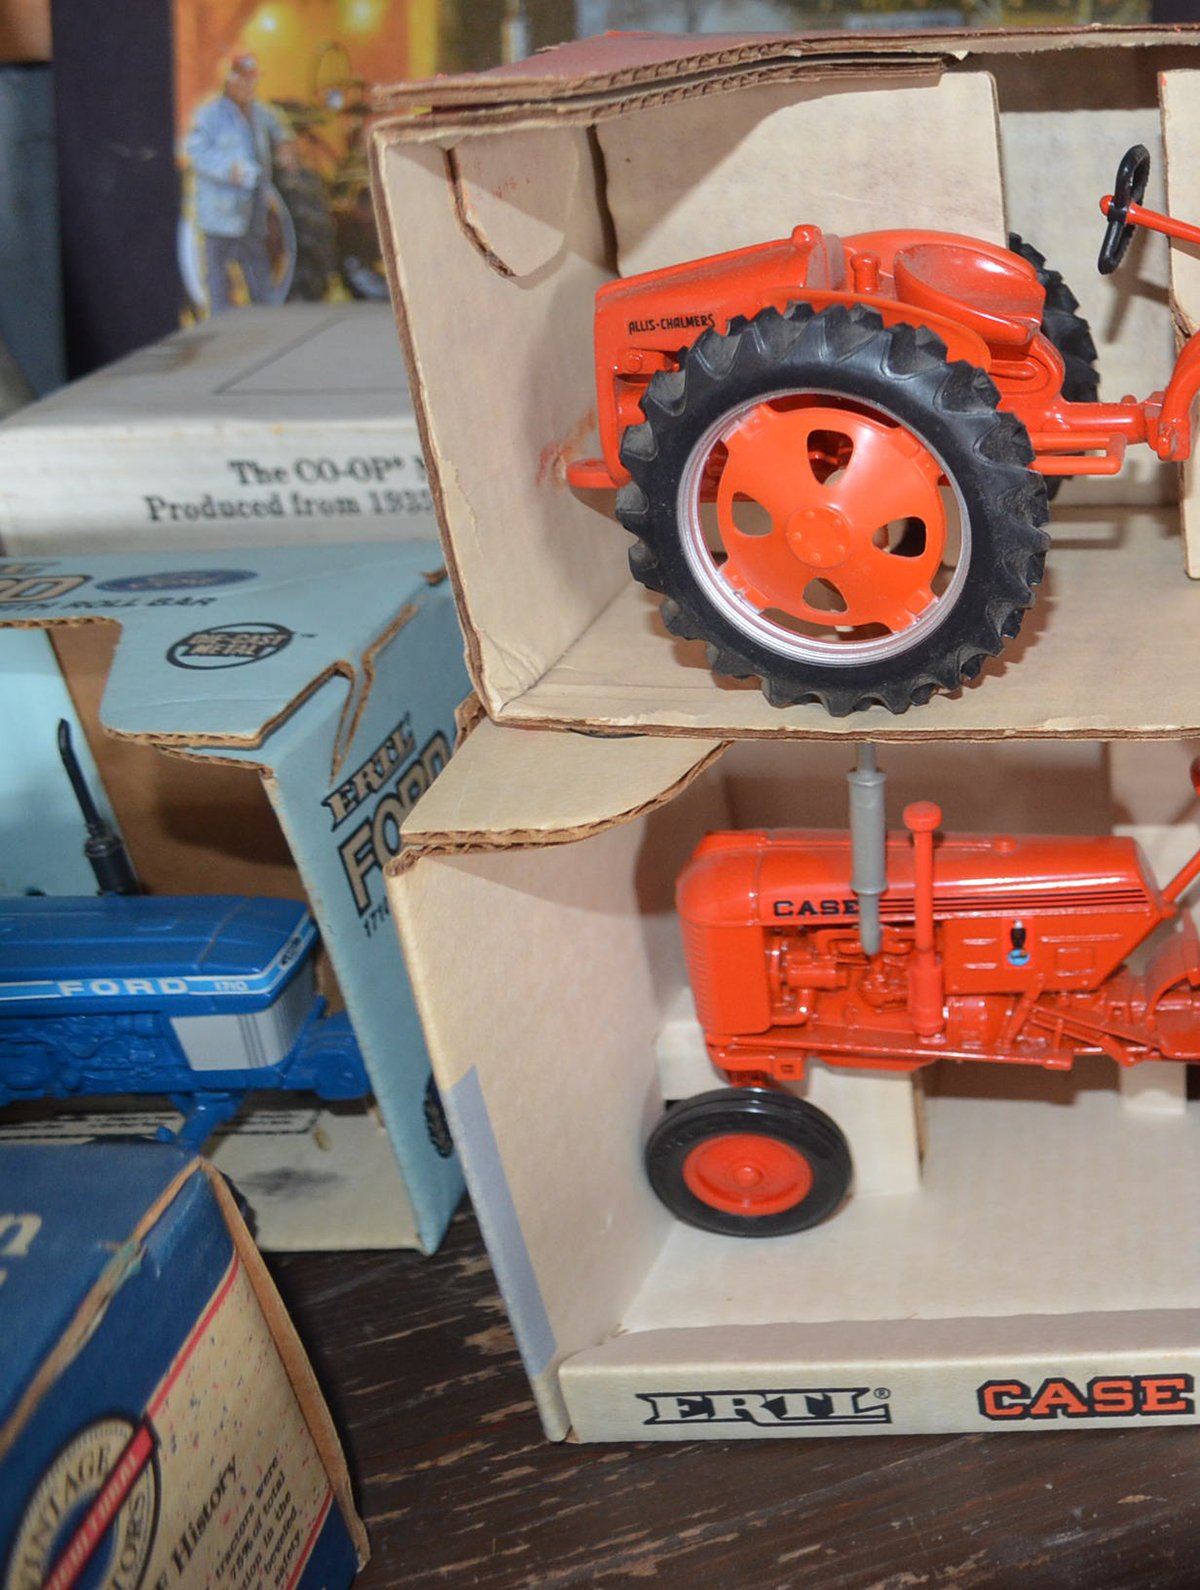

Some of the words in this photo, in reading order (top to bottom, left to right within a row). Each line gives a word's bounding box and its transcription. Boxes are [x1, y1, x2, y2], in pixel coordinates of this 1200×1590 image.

[228, 460, 288, 486] The
[144, 496, 284, 522] Produced
[290, 491, 360, 517] from
[60, 598, 141, 610] ROLL
[145, 596, 218, 608] BAR
[183, 643, 264, 657] METAL
[773, 899, 860, 917] CASE
[58, 977, 190, 997] FORD
[977, 1374, 1195, 1421] CASE
[262, 1470, 286, 1517] total
[275, 1489, 292, 1522] the
[170, 1453, 237, 1577] History
[214, 1502, 255, 1581] tractors
[255, 1455, 280, 1499] were
